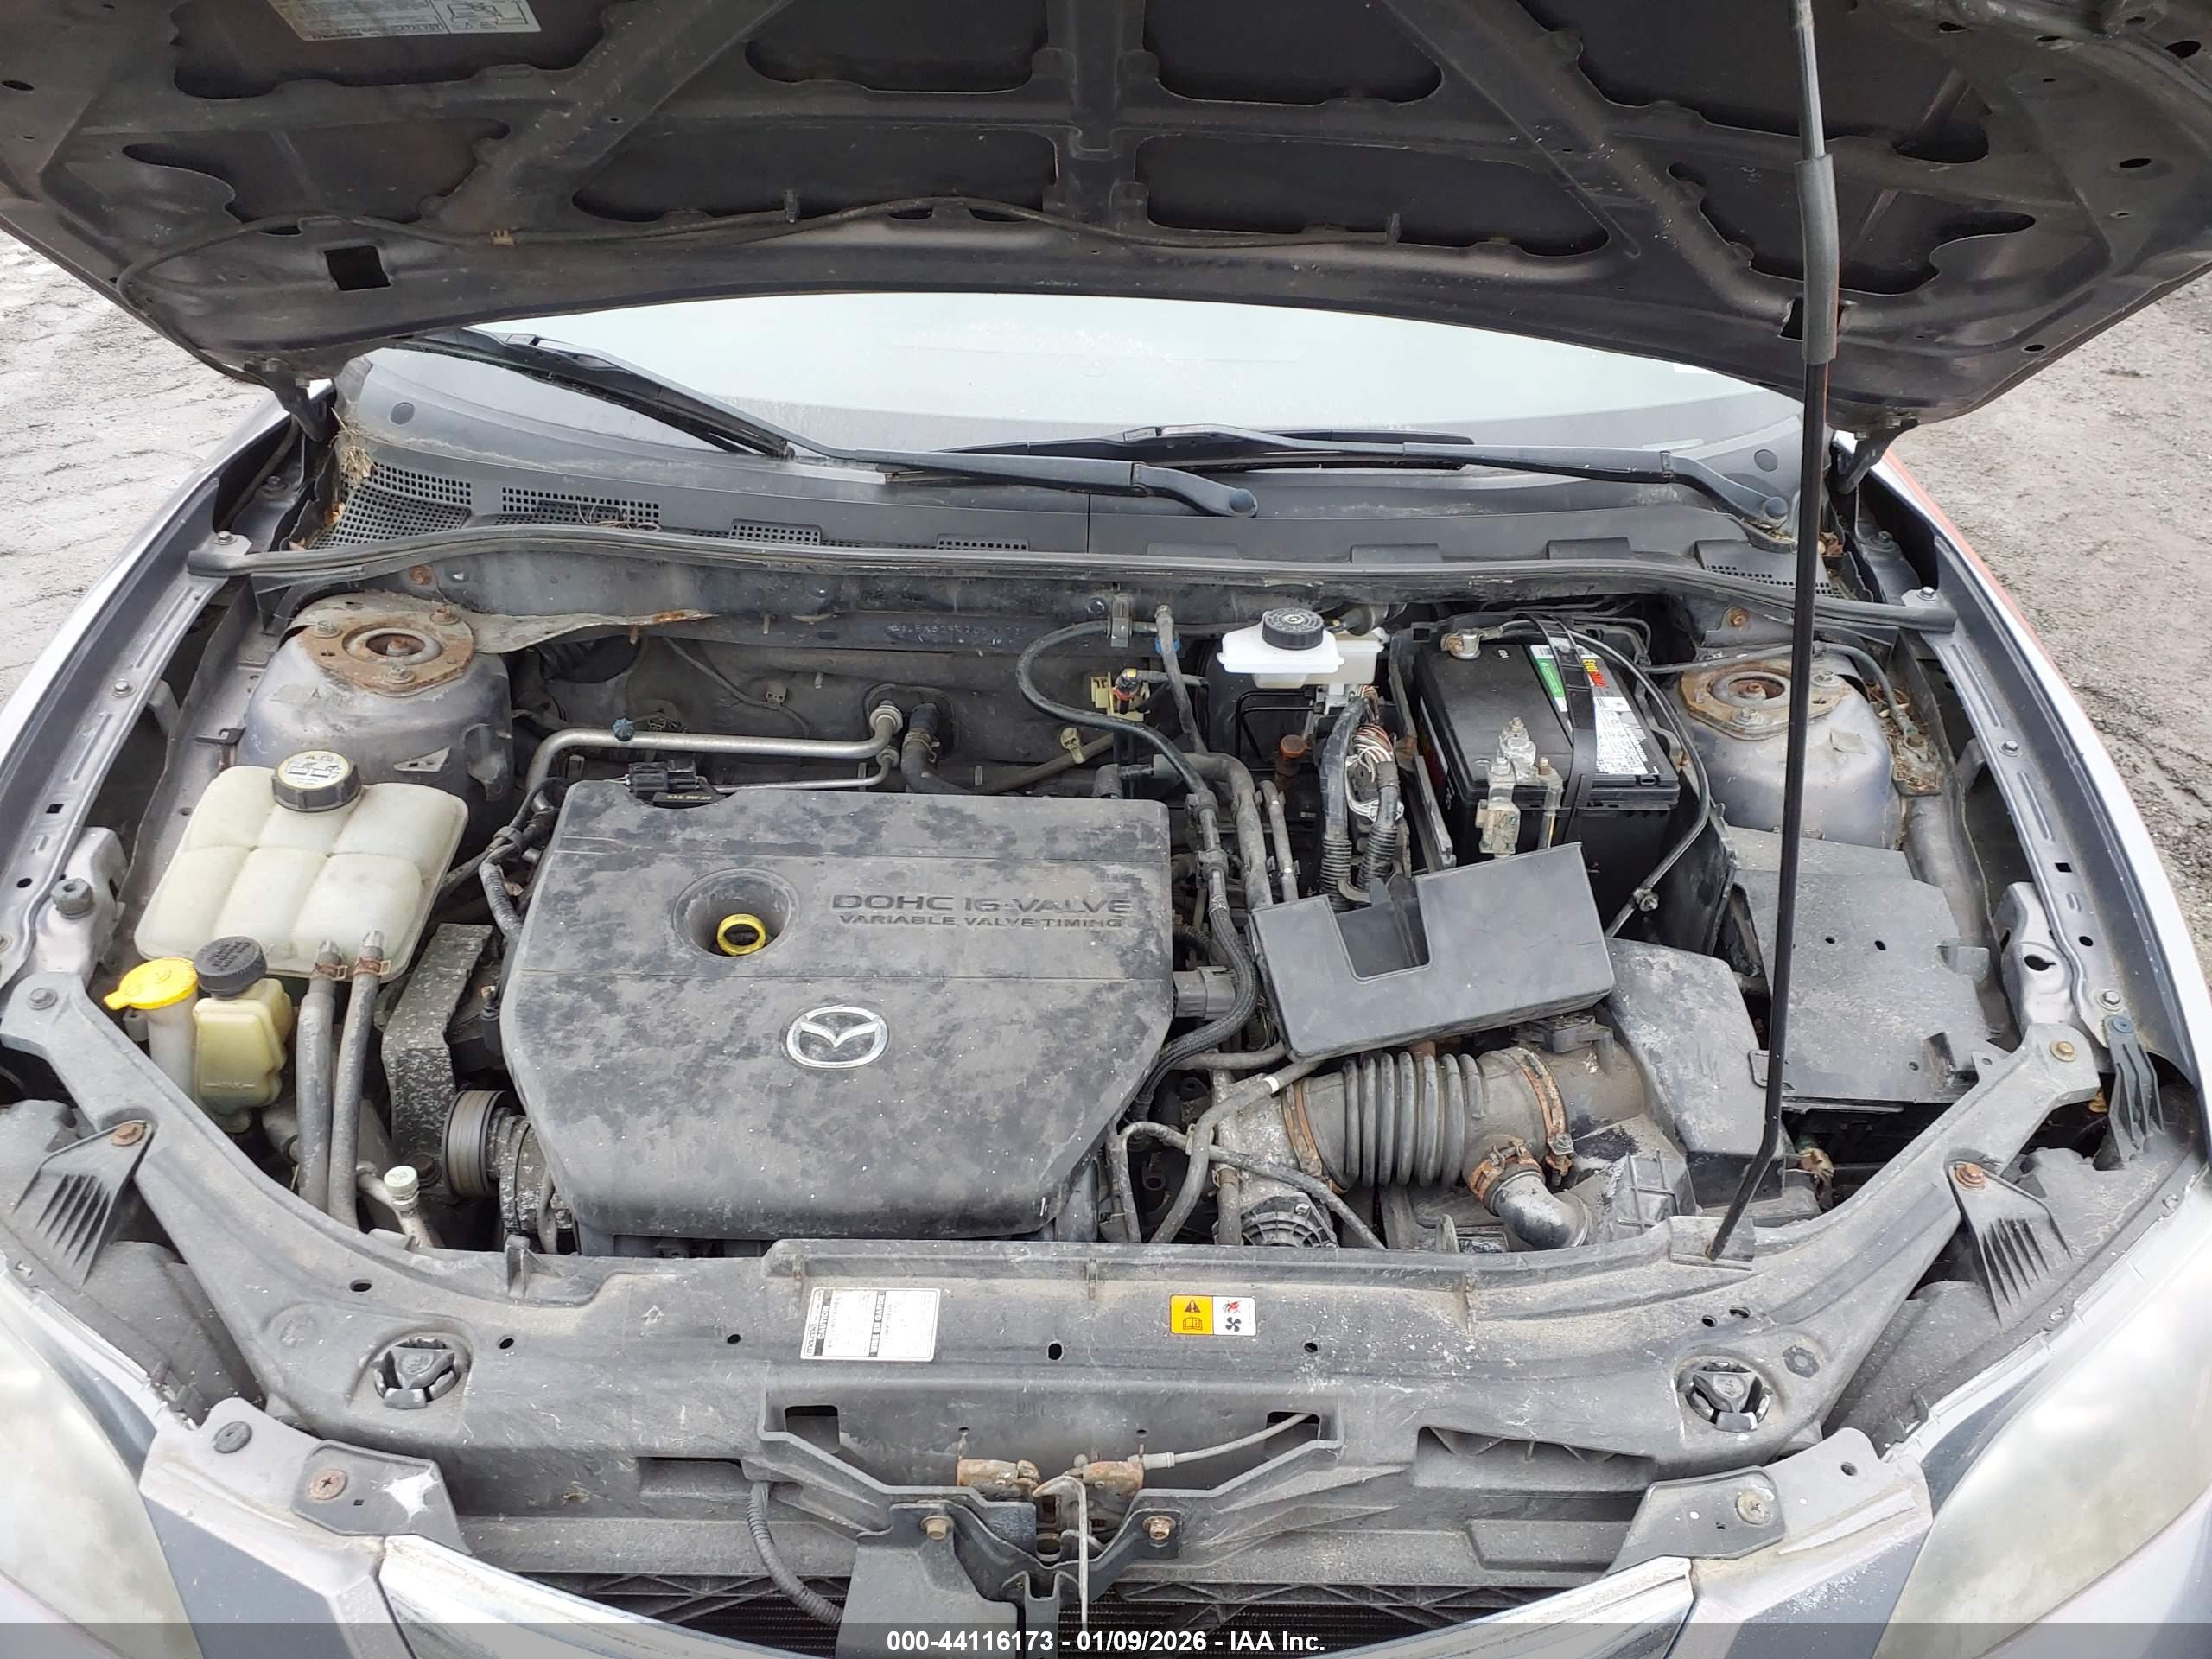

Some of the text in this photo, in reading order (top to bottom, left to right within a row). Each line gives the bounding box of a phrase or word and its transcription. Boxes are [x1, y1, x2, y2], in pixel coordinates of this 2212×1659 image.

[832, 894, 1133, 914] DOHC 16-VALVE
[839, 914, 1122, 929] VARIABLE VALVE TIMING
[817, 1305, 830, 1340] CAUTION
